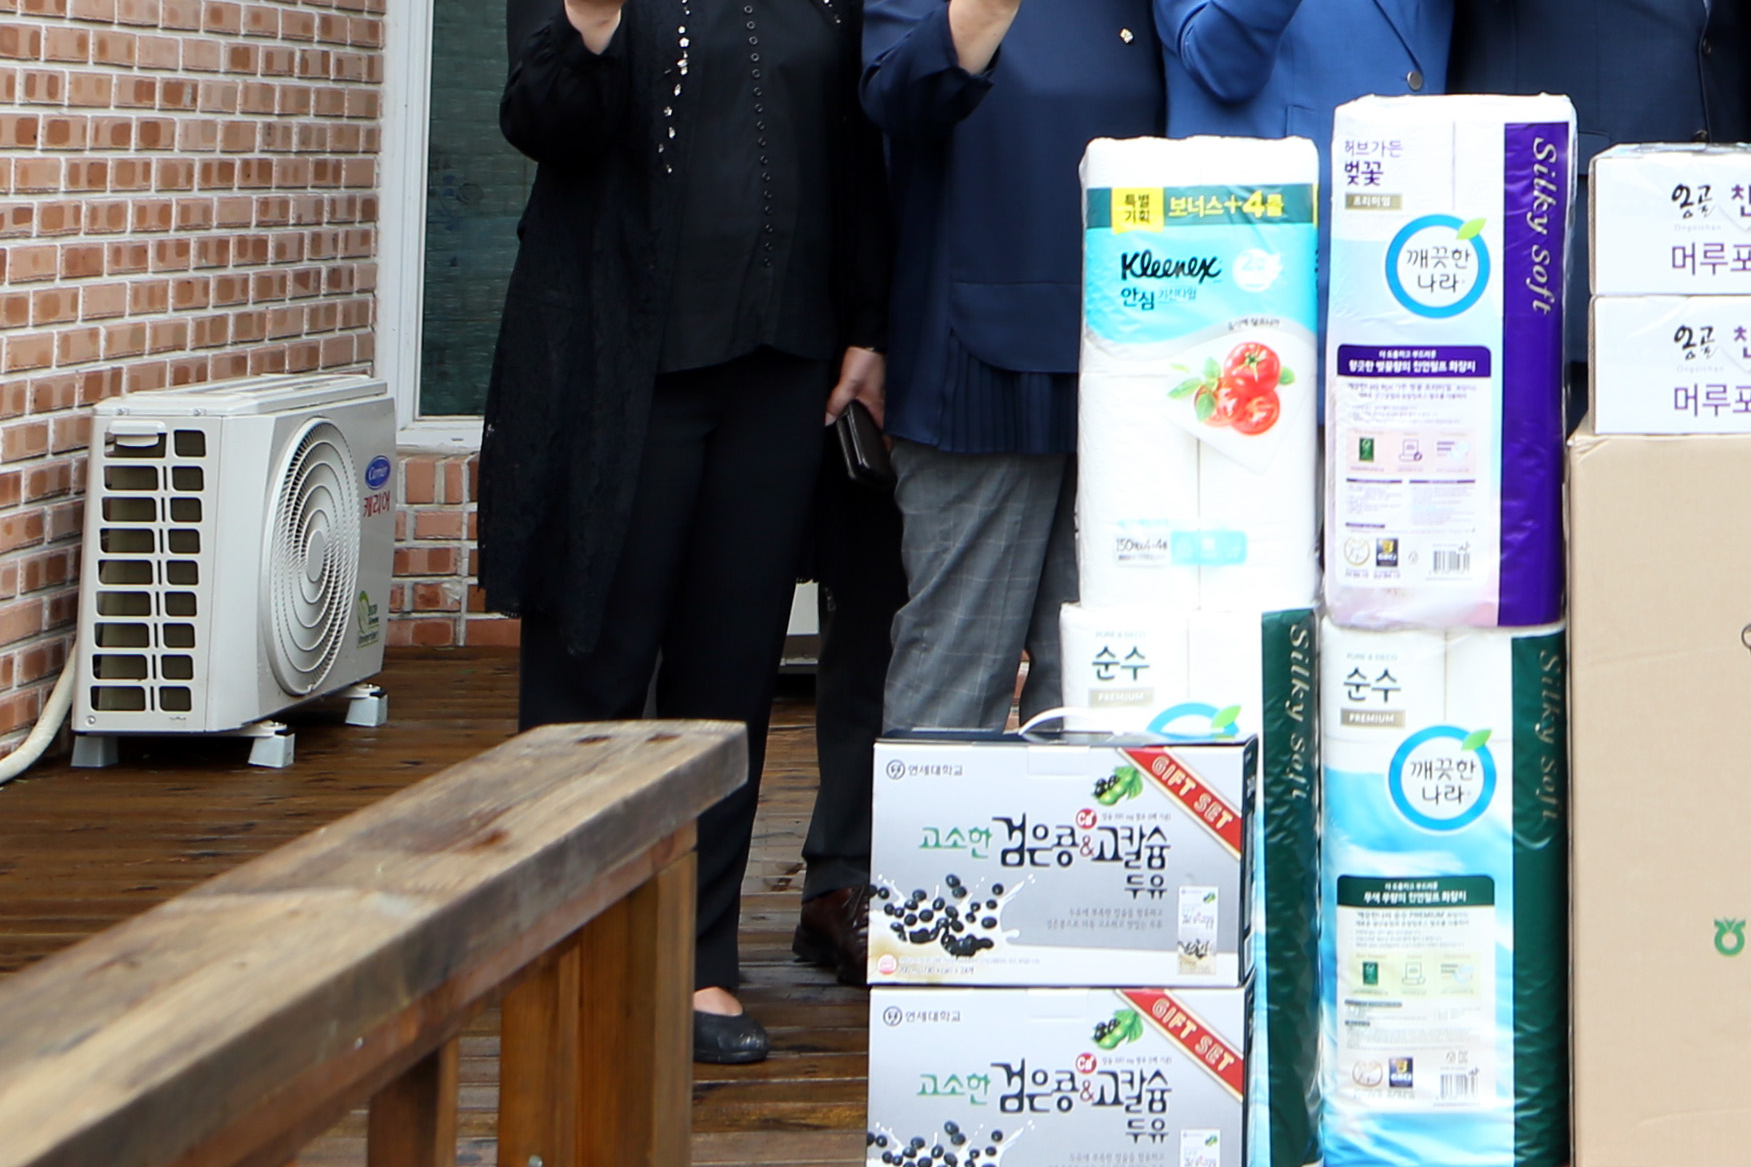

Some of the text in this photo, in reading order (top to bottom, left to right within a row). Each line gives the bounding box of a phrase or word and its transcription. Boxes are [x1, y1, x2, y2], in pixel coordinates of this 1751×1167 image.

[1345, 140, 1404, 157] 허브가든
[1345, 160, 1384, 186] 벚꽃
[1526, 137, 1557, 235] Silky
[1125, 194, 1150, 208] 특별
[1353, 196, 1391, 207] 프리미엄
[1125, 210, 1150, 223] 기획
[1121, 249, 1222, 284] Kleenex
[1406, 247, 1471, 270] 깨끗한
[1417, 274, 1460, 293] 나라
[1121, 287, 1154, 310] 안심
[1092, 646, 1150, 681] 순수
[1285, 624, 1310, 722] Silky
[1098, 692, 1145, 702] PREMIUM
[1344, 667, 1402, 703] 순수
[1534, 650, 1561, 744] Silky
[1349, 713, 1395, 723] PREMIUM
[908, 764, 963, 777] 연세대학교
[1410, 758, 1476, 782] 깨끗한
[1151, 755, 1235, 831] GIFT SET
[1422, 785, 1465, 805] 나라
[919, 826, 992, 859] 고소한
[1125, 874, 1168, 900] 두유
[906, 1010, 961, 1023] 연세대학교
[1152, 998, 1235, 1073] GIFT SET
[917, 1073, 991, 1105] 고소한
[1125, 1118, 1169, 1144] 두유
